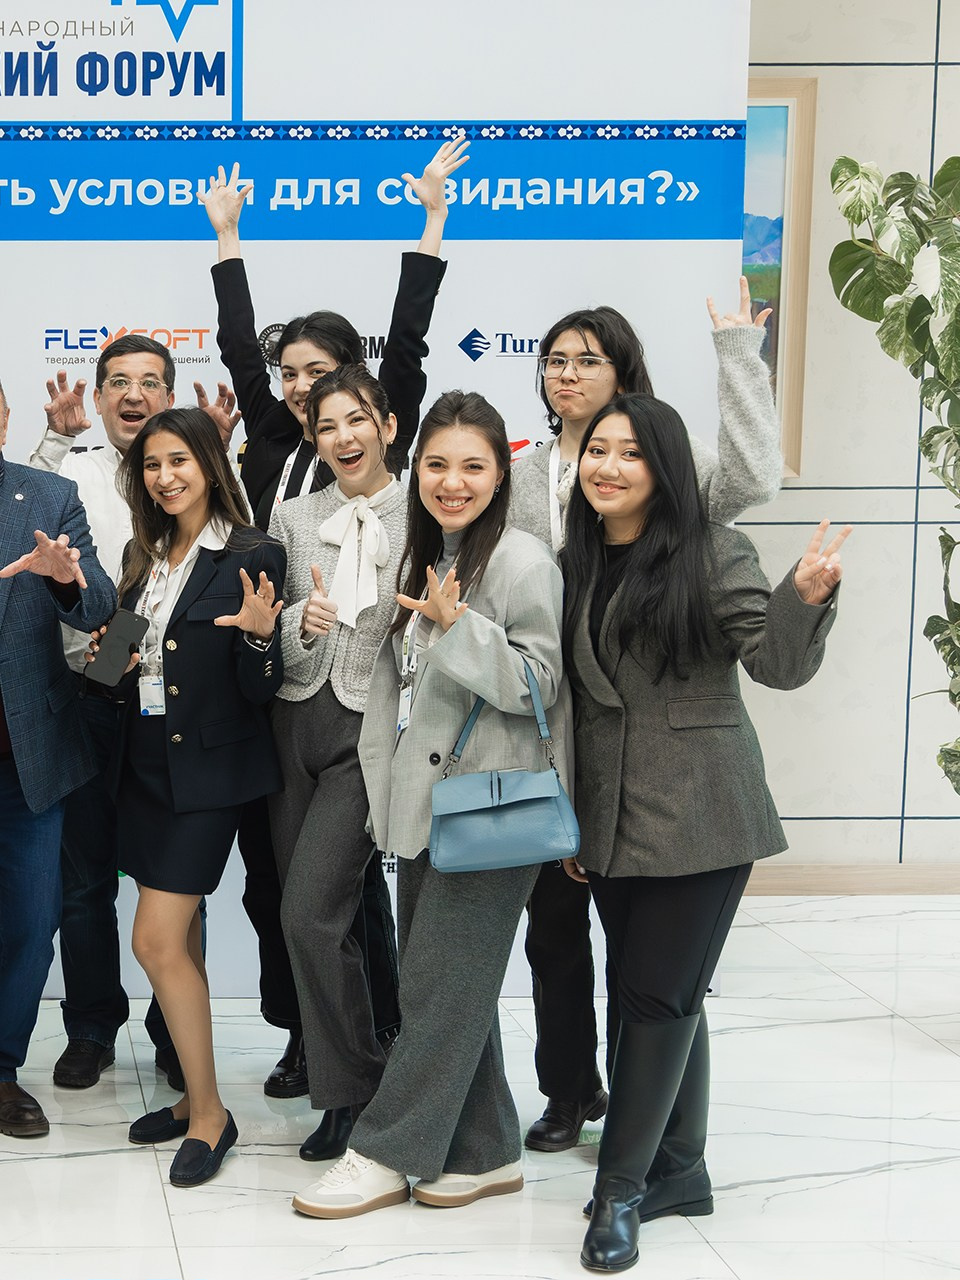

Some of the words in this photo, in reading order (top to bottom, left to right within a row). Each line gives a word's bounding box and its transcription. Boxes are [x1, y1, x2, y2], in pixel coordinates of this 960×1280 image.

[76, 50, 225, 97] ФОРУМ
[270, 178, 359, 211] для
[45, 356, 86, 365] твердая
[173, 355, 211, 364] ешений
